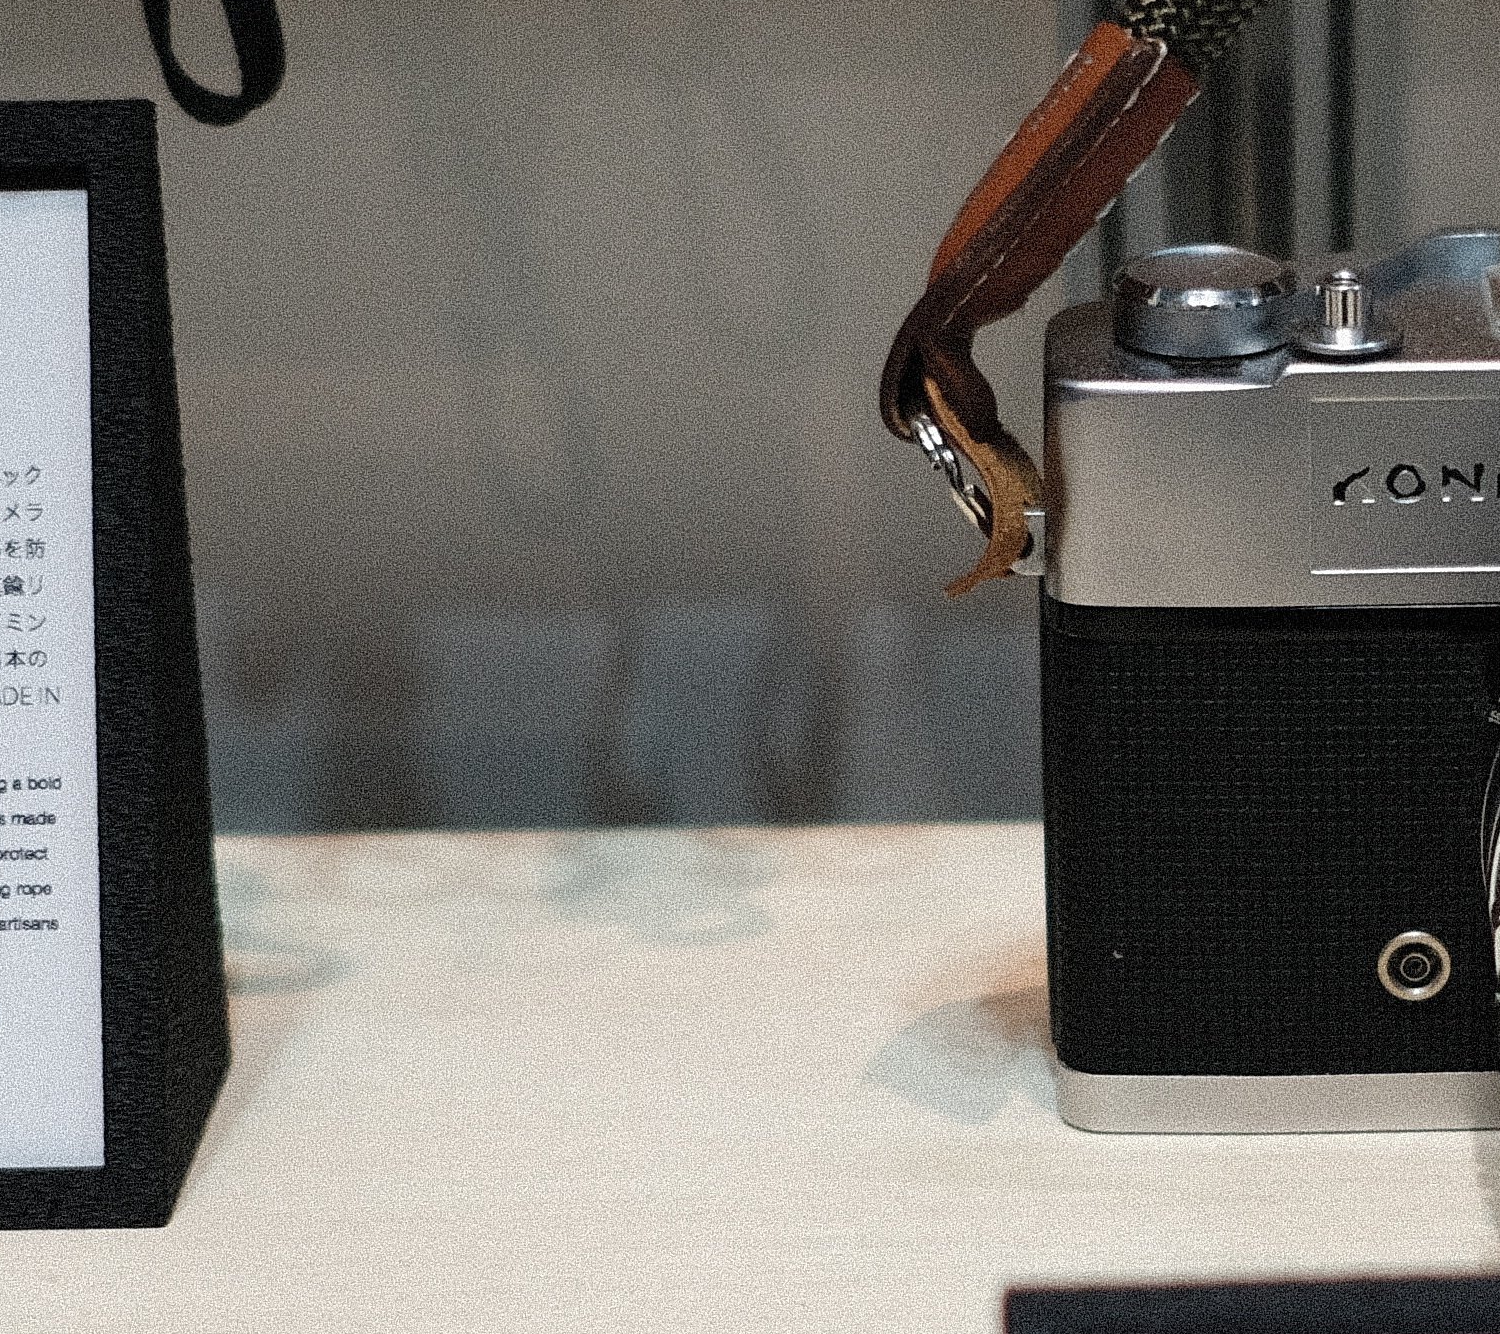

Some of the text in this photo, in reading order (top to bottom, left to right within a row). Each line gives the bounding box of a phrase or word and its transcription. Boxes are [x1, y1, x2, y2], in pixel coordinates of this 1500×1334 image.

[12, 779, 24, 793] a
[27, 777, 63, 792] bold
[11, 812, 58, 828] made
[16, 884, 53, 900] rope
